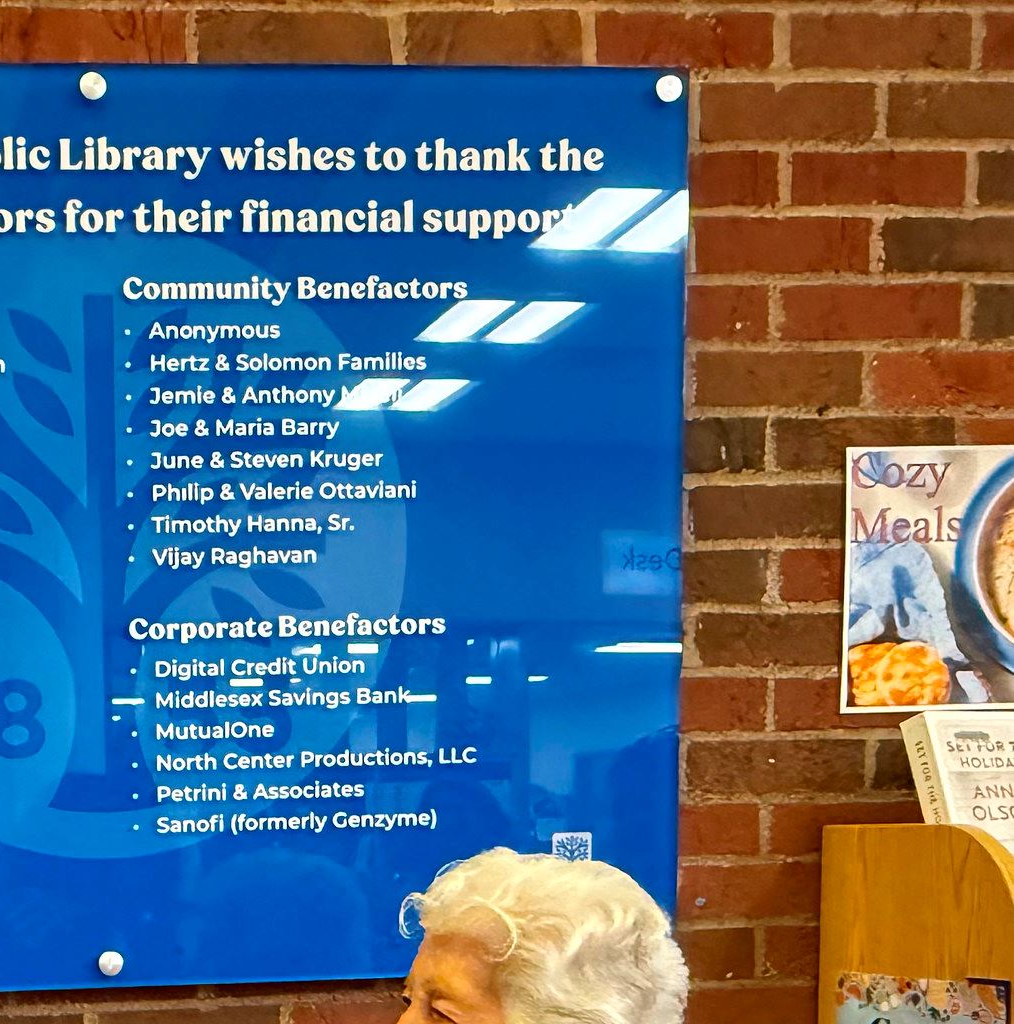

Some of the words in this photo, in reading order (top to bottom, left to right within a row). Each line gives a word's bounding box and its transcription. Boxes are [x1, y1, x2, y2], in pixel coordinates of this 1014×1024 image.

[58, 135, 212, 180] Library
[219, 136, 356, 171] wishes
[363, 141, 407, 172] to
[414, 137, 531, 172] thank
[538, 138, 605, 172] the
[62, 198, 125, 233] for
[132, 198, 233, 233] their
[239, 198, 414, 233] financial
[122, 275, 292, 307] Community
[297, 274, 468, 300] Benefactors
[148, 321, 281, 344] Anonymous
[150, 354, 210, 373] Hertz
[214, 353, 230, 372] &
[235, 352, 332, 372] Solomon
[338, 351, 427, 371] Families
[149, 384, 216, 405] Jemie
[221, 386, 237, 405] &
[241, 385, 336, 408] Anthony
[149, 419, 189, 438] Joe
[194, 418, 210, 437] &
[215, 417, 275, 437] Maria
[281, 418, 340, 440] Barry
[150, 451, 205, 470] June
[209, 451, 225, 469] &
[230, 450, 304, 469] Steven
[310, 449, 384, 472] Kruger
[851, 451, 953, 499] Cozy
[152, 482, 215, 506] Philip
[219, 483, 236, 501] &
[239, 480, 314, 501] Valerie
[318, 479, 417, 500] Ottaviani
[150, 514, 242, 538] Timothy
[247, 514, 323, 535] Hanna,
[327, 513, 355, 532] Sr.
[851, 505, 964, 545] Meals
[151, 546, 206, 570] Vijay
[211, 545, 318, 569] Raghavan
[128, 617, 273, 644] Corporate
[277, 612, 447, 638] Benefactors
[154, 658, 225, 682] Digital
[231, 657, 296, 676] Credit
[302, 656, 365, 674] Union
[155, 689, 264, 709] Middlesex
[268, 686, 352, 710] Savings
[356, 685, 411, 705] Bank
[156, 720, 275, 741] MutualOne
[156, 752, 218, 772] North
[222, 752, 295, 770] Center
[300, 747, 433, 768] Productions,
[438, 746, 477, 764] LLC
[156, 782, 227, 803] Petrini
[232, 783, 248, 801] &
[252, 780, 365, 800] Associates
[156, 813, 225, 834] Sanofi
[230, 811, 328, 836] (formerly
[332, 808, 437, 832] Genzyme)
